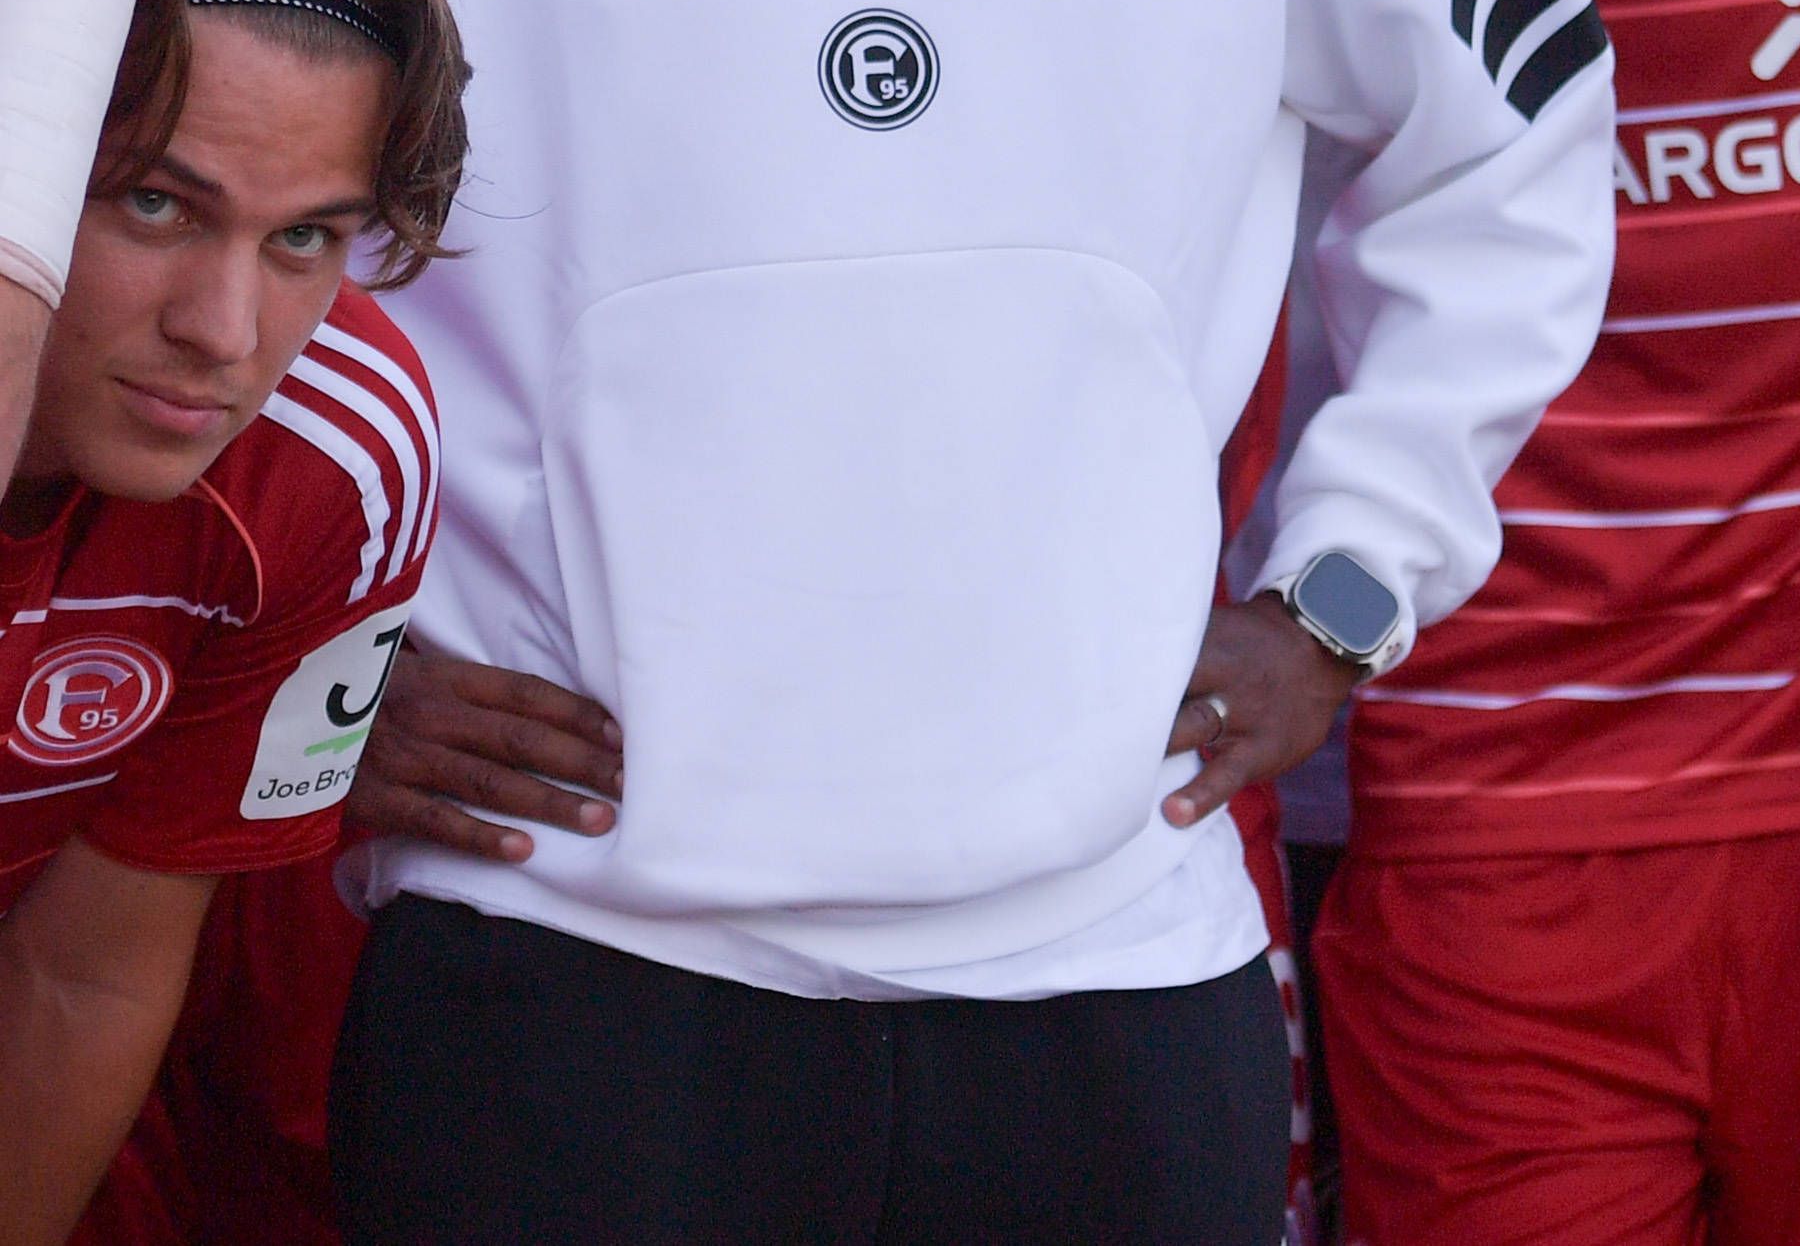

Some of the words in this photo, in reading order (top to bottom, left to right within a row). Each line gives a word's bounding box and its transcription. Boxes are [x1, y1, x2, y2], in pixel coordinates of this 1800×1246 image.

[848, 33, 908, 106] F
[879, 79, 909, 100] 95
[35, 661, 134, 740] F
[78, 708, 119, 731] 95
[257, 777, 311, 800] Joe
